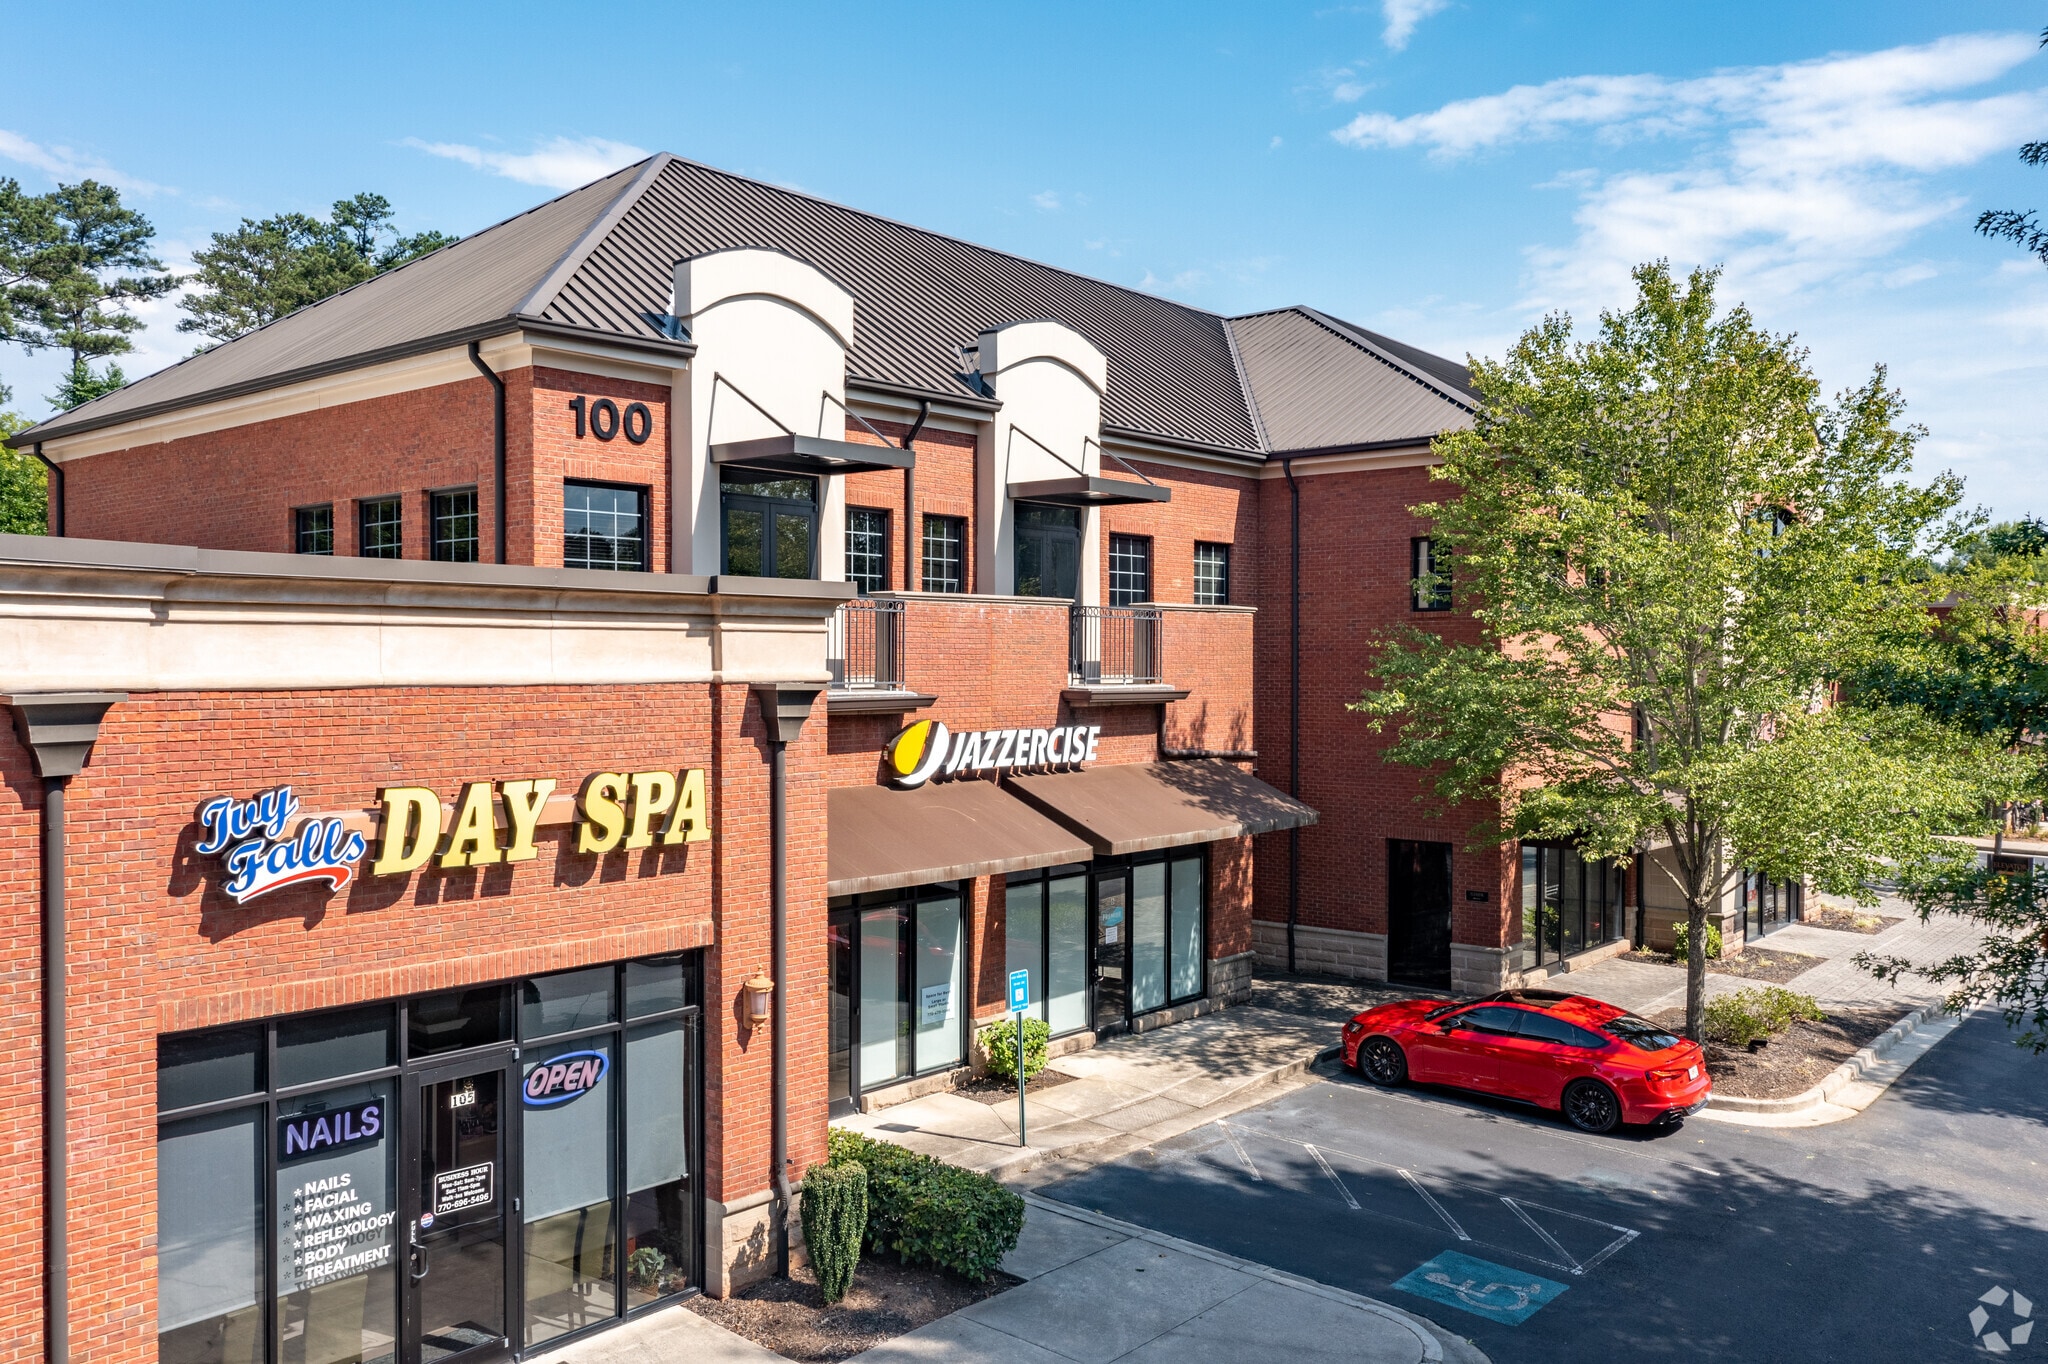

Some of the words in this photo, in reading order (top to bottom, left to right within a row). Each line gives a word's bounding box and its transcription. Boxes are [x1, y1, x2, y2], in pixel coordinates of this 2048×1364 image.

[569, 395, 652, 445] 100
[946, 726, 1100, 775] JAZZERCISE
[197, 786, 299, 853] Ivy
[374, 778, 557, 876] DAY
[578, 768, 712, 854] SPA
[227, 818, 367, 894] Falls
[527, 1059, 601, 1097] OPEN
[452, 1091, 474, 1108] 105
[286, 1106, 380, 1154] NAILS
[305, 1173, 351, 1196] NAILS
[438, 1170, 469, 1184] BUSINESS
[471, 1166, 488, 1176] HOUR
[305, 1189, 358, 1213] FACIAL
[306, 1202, 372, 1230] WAXING
[438, 1192, 489, 1212] 770-696-5496
[304, 1211, 396, 1248] REFLEXOLOGY
[305, 1241, 347, 1265] BODY
[305, 1244, 391, 1281] TREATMENT
